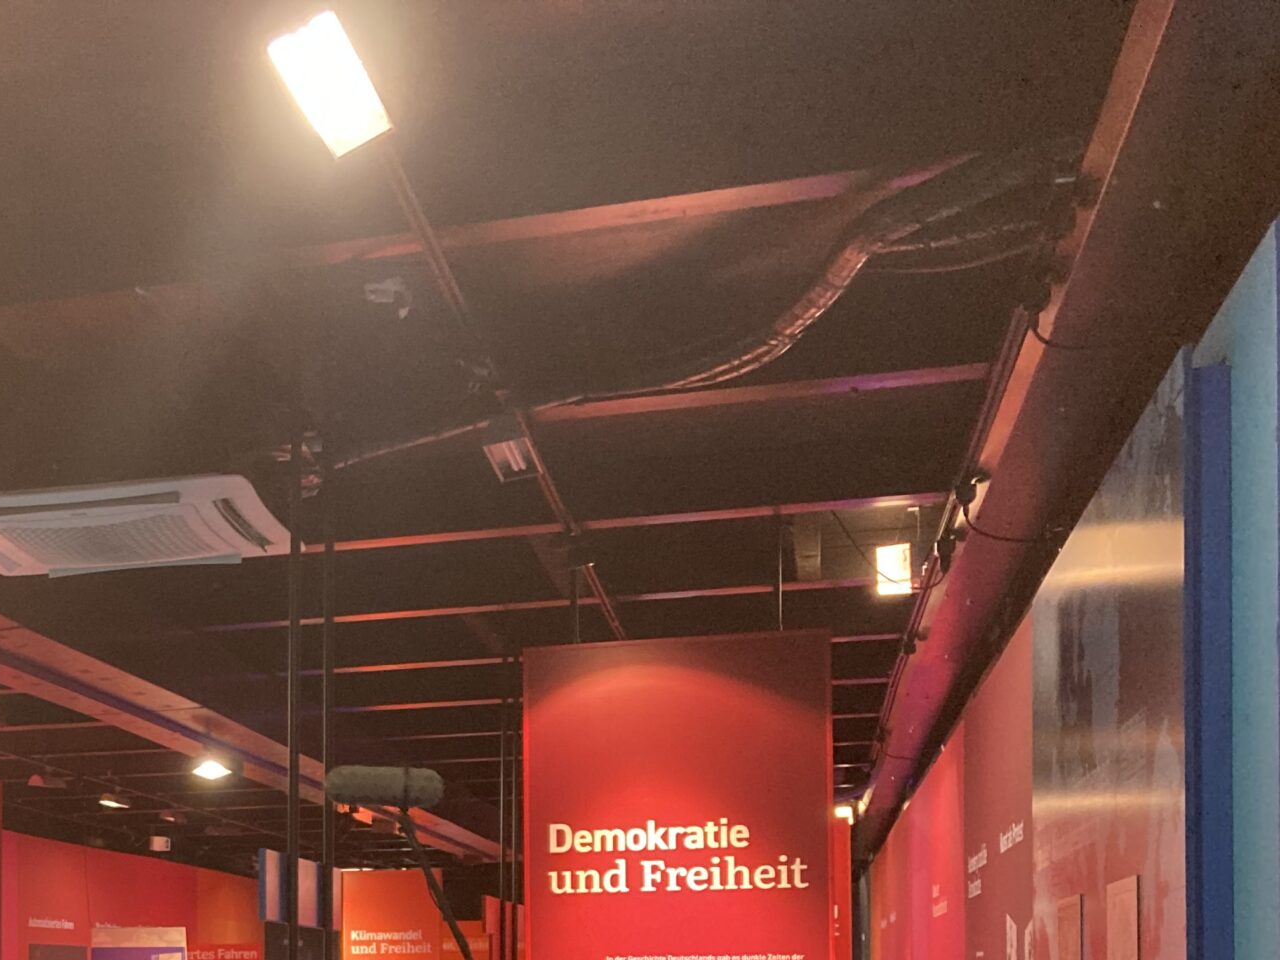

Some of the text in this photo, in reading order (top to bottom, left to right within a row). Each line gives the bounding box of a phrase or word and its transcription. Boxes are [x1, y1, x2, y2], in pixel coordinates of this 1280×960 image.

[548, 818, 750, 854] Demokratie
[548, 855, 810, 894] und Freiheit
[350, 929, 423, 941] Klimawandel
[218, 949, 258, 960] Fahren
[351, 943, 377, 955] und
[380, 942, 433, 954] Freiheit
